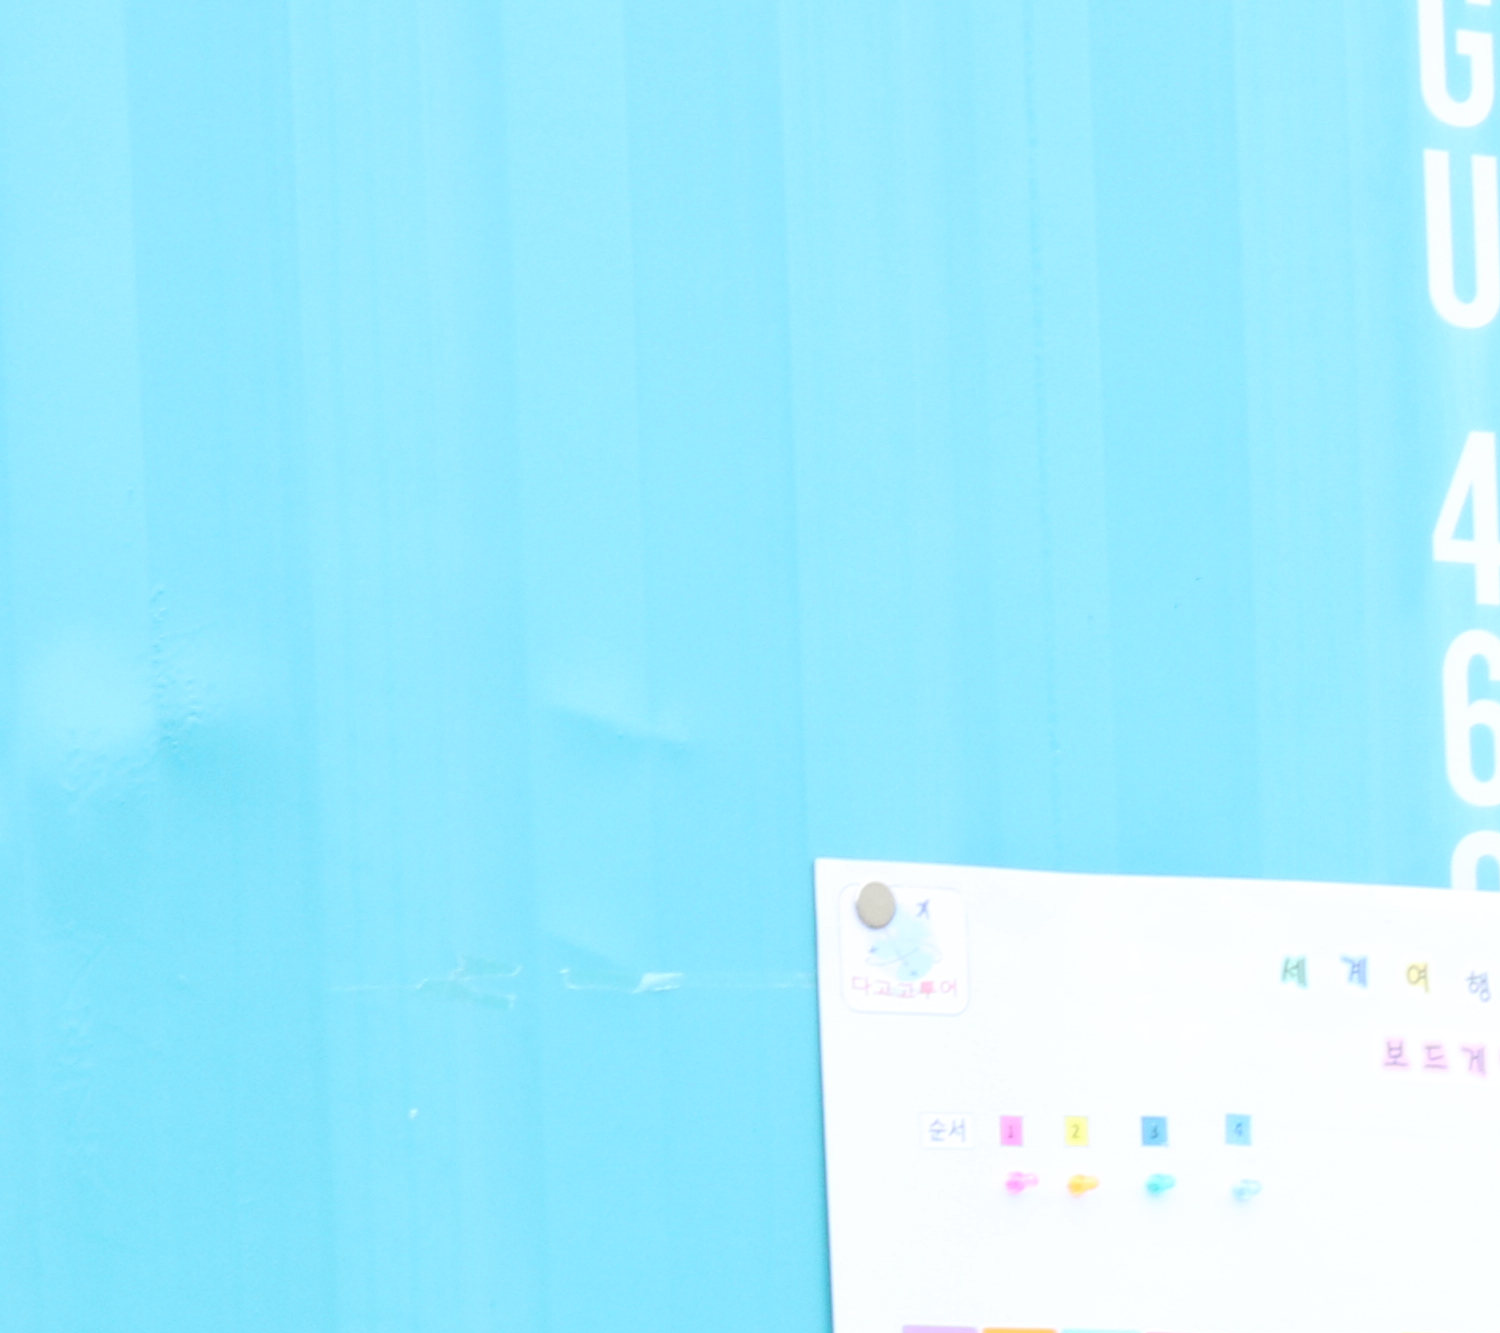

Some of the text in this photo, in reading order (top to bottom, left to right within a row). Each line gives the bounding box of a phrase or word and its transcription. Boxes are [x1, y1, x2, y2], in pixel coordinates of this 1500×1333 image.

[927, 1117, 968, 1143] 순서
[1071, 1124, 1081, 1139] 2
[1151, 1124, 1160, 1139] 3
